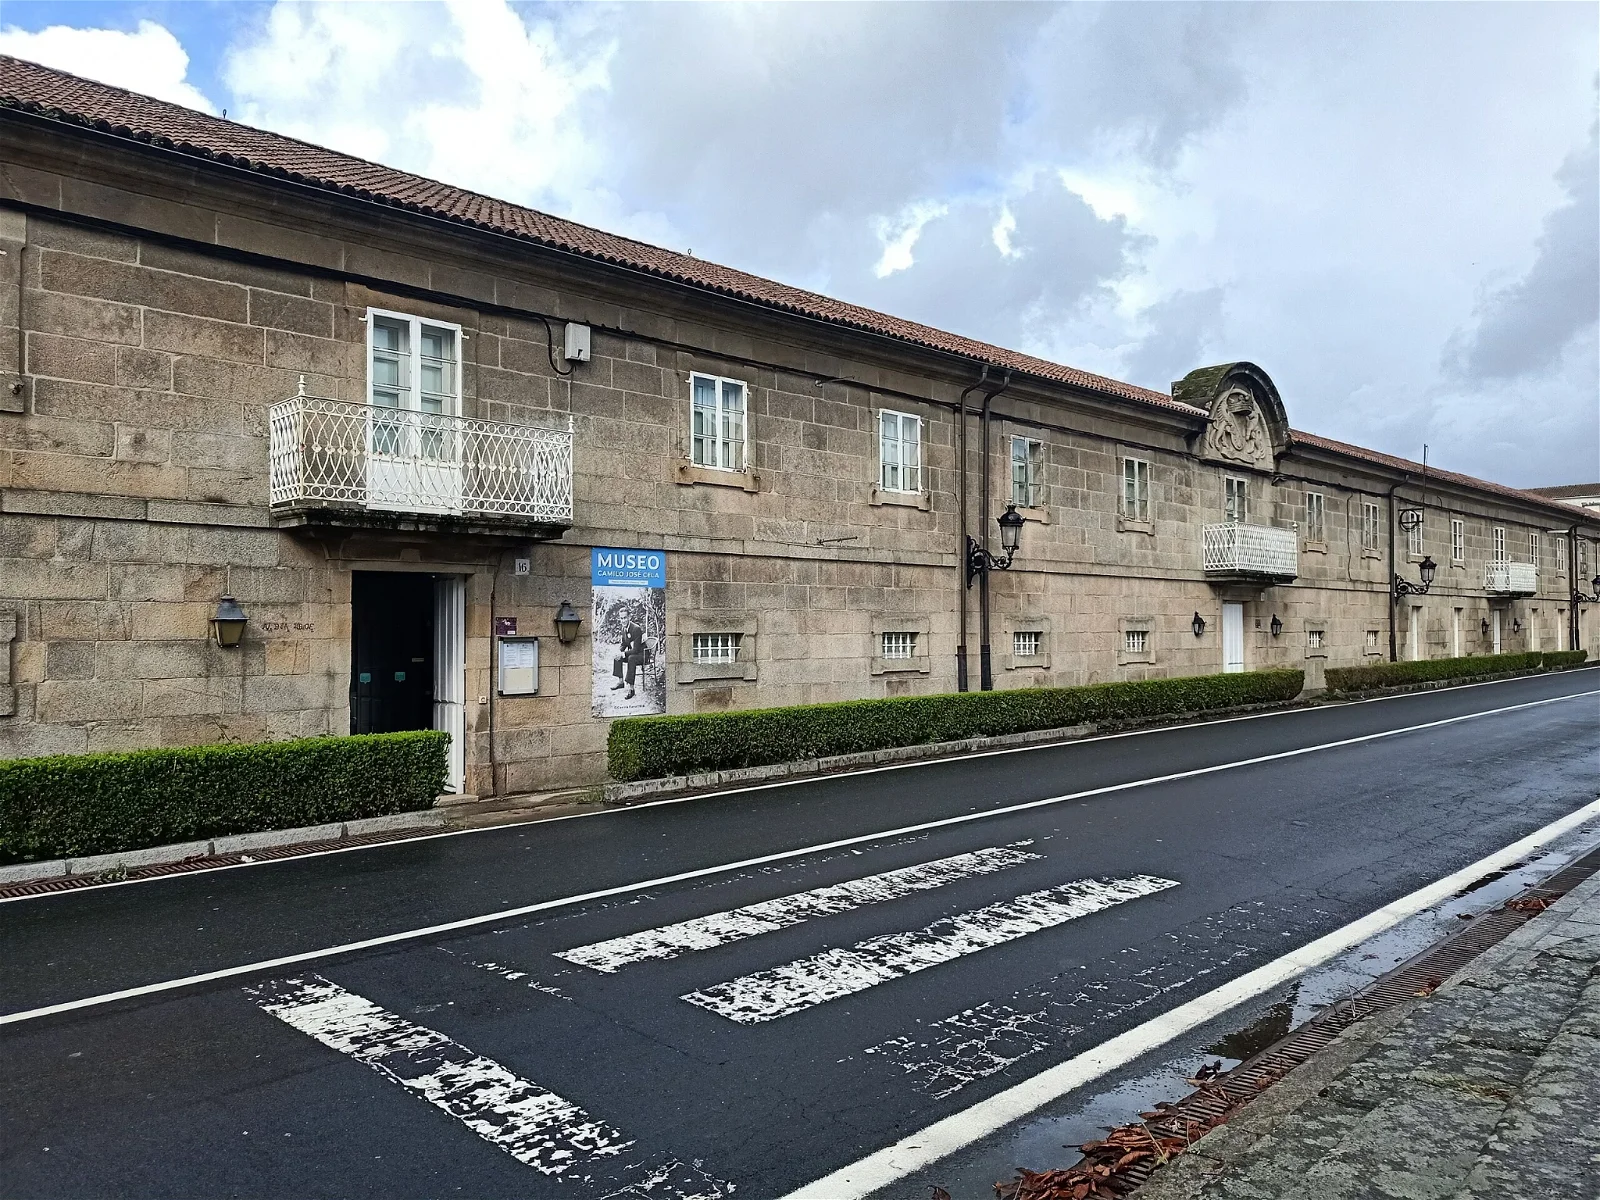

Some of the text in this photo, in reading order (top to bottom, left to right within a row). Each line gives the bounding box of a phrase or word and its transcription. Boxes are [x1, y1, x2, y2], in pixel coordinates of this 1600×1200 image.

[597, 552, 660, 570] MUSEO
[518, 562, 528, 573] 16
[625, 570, 642, 578] JOSÉ
[642, 571, 660, 579] CELA
